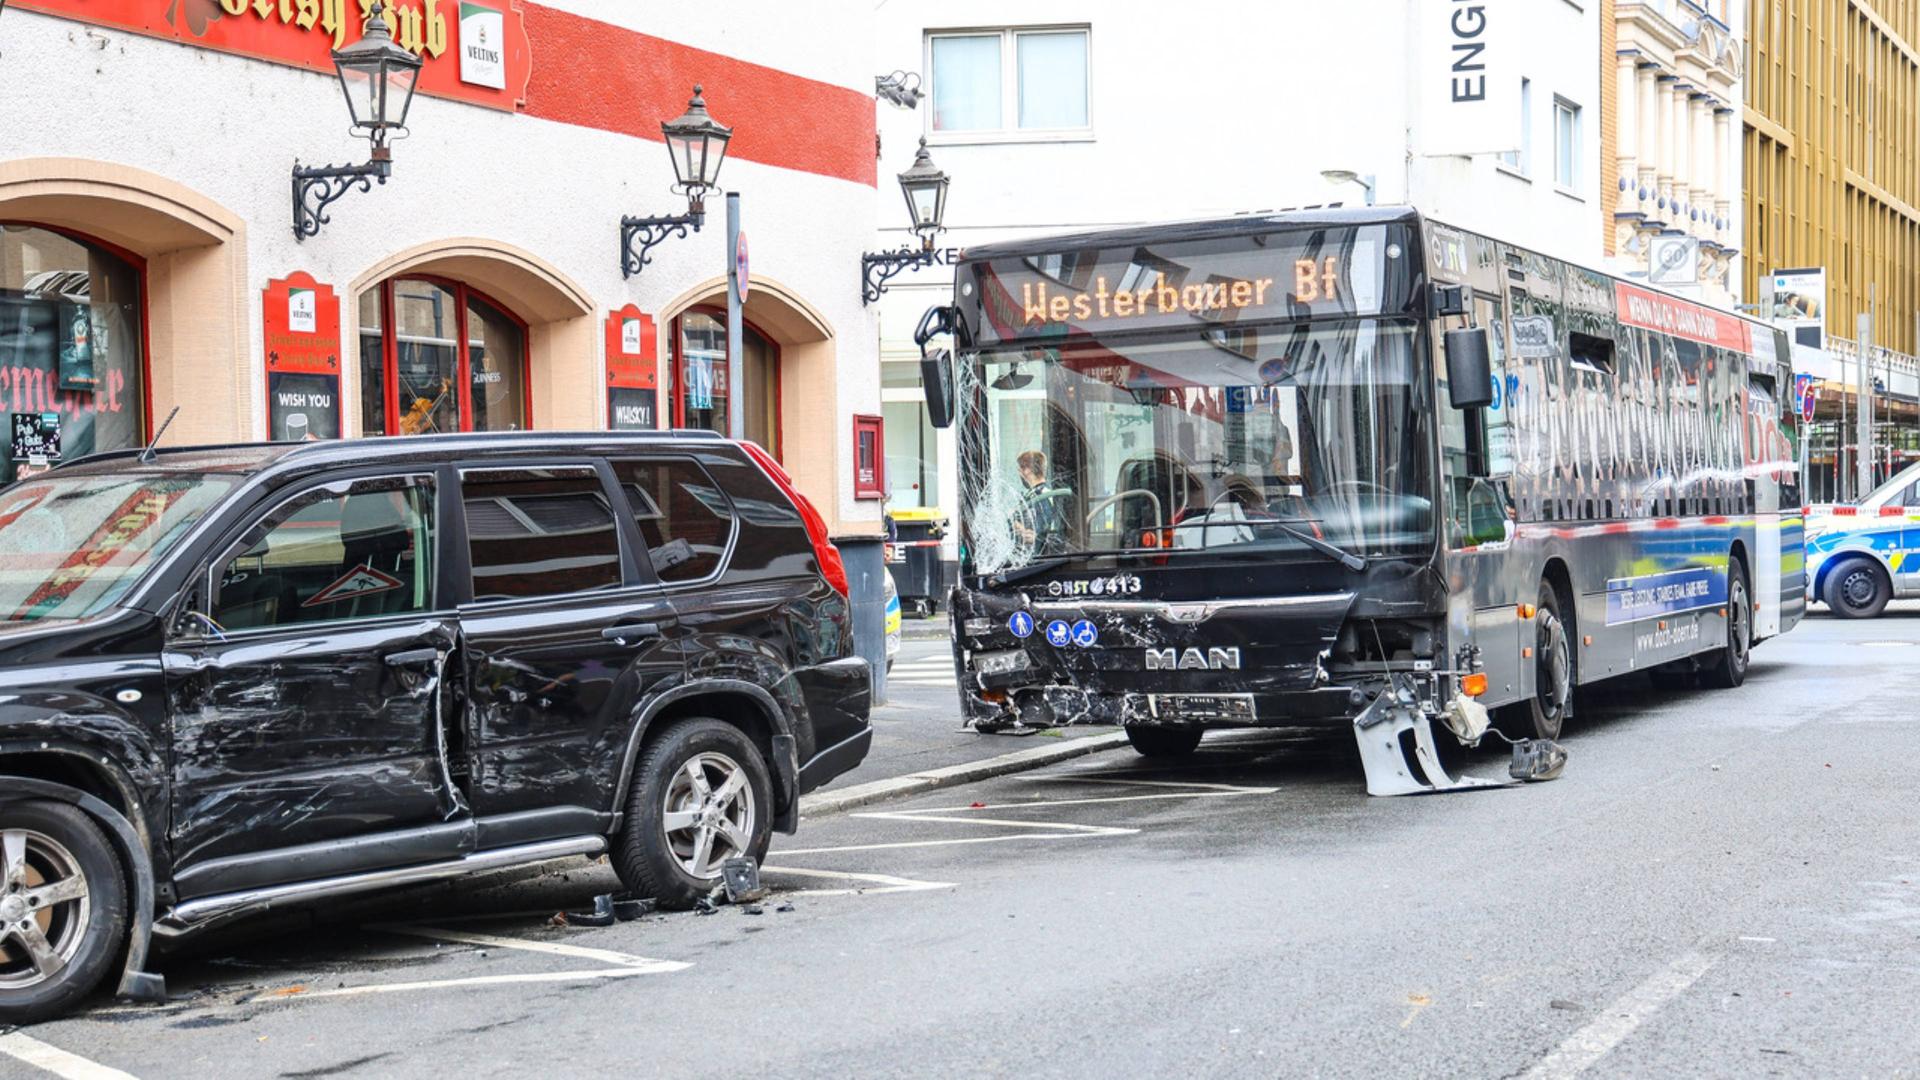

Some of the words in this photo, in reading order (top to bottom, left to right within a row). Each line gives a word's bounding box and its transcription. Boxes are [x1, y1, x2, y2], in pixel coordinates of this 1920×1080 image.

[467, 44, 499, 64] VELTINS
[1450, 0, 1487, 103] ENG
[1023, 272, 1273, 324] Westerbauer
[1295, 257, 1337, 302] Bf
[278, 393, 306, 408] WISH
[308, 394, 331, 408] YOU
[1105, 576, 1142, 595] 413
[1145, 646, 1241, 671] MAN
